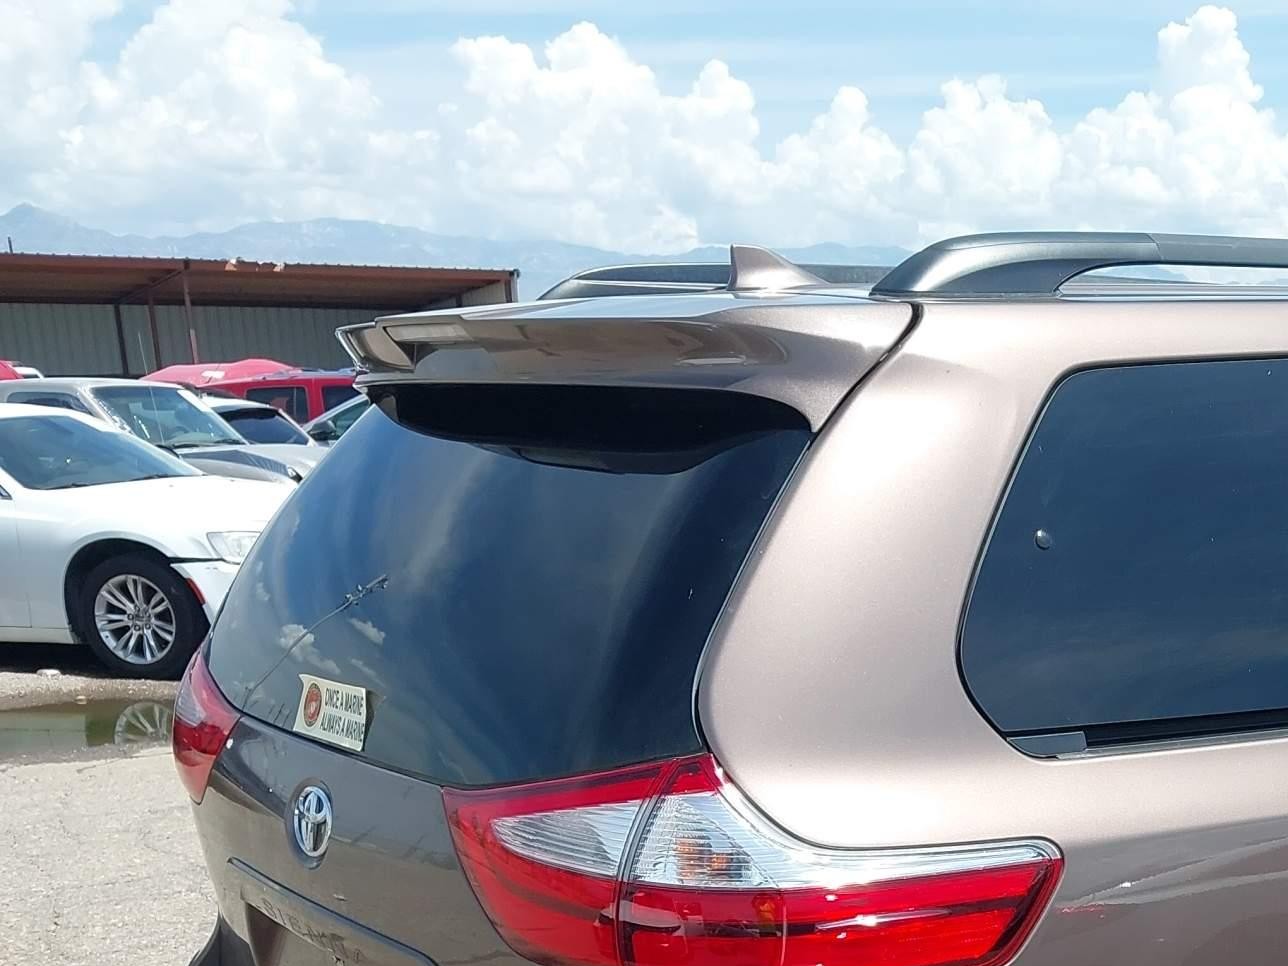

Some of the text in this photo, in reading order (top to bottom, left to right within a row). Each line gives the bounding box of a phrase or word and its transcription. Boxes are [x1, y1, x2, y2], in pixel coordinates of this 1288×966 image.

[325, 688, 340, 709] ONCE
[344, 692, 364, 716] MARINE
[320, 711, 342, 736] ALWAYS
[345, 719, 365, 742] MARINE
